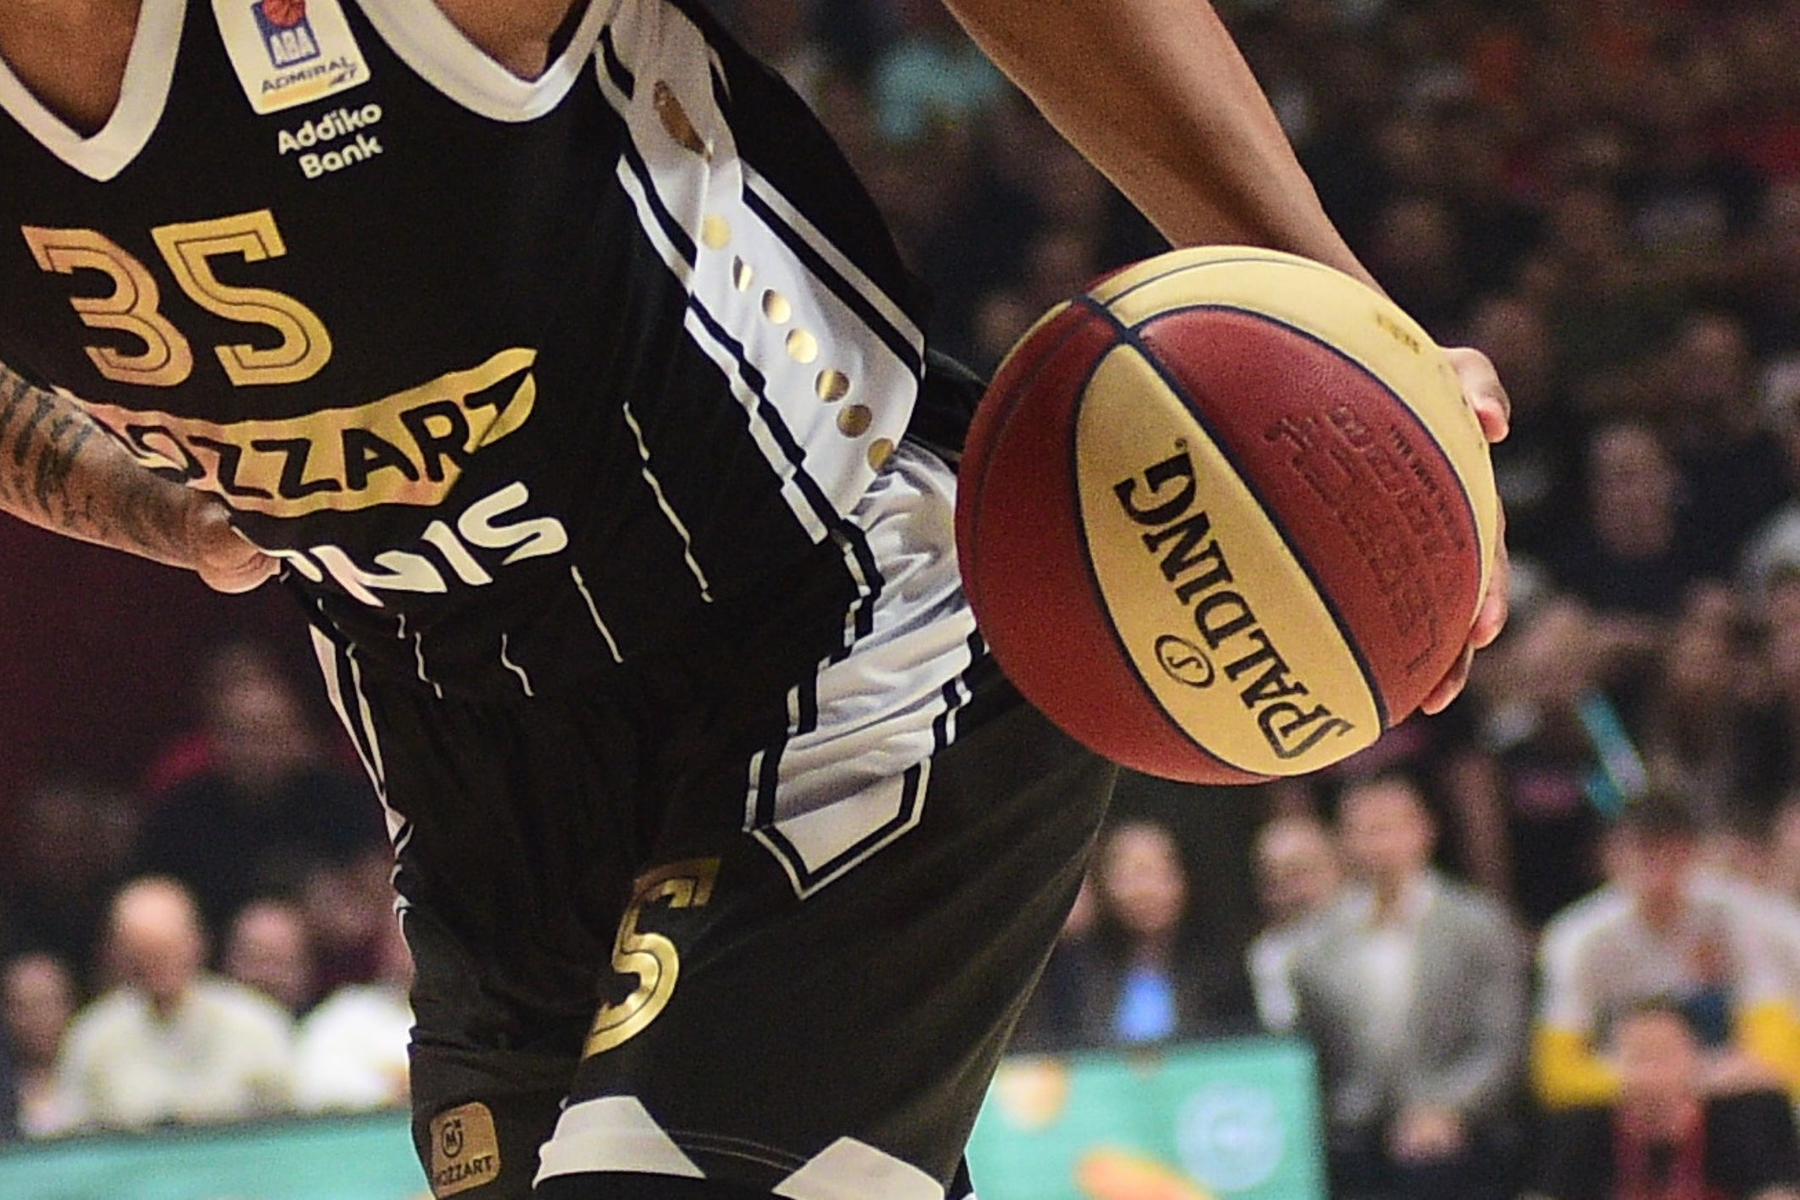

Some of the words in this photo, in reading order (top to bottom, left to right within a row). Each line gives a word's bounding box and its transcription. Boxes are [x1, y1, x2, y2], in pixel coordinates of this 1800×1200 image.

[262, 56, 357, 94] ADMIRAL
[278, 103, 382, 155] Addiko
[298, 133, 384, 179] Bank
[21, 209, 333, 387] 35
[1114, 451, 1355, 760] SPALDING
